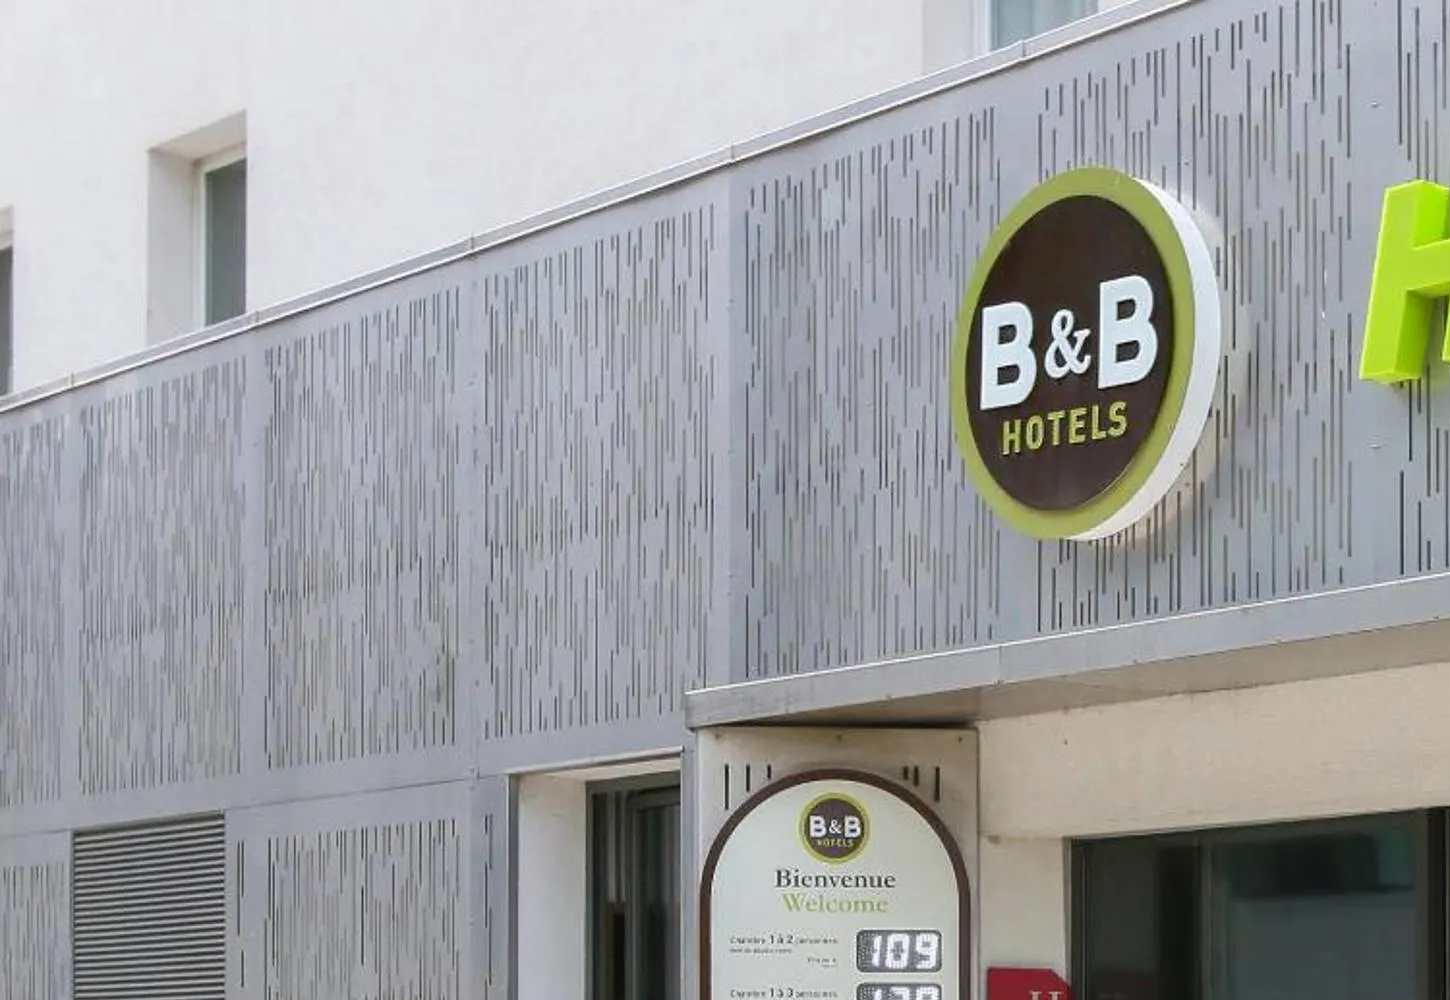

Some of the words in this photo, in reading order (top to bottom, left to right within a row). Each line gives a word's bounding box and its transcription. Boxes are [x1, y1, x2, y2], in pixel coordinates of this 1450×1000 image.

[979, 274, 1159, 411] B&B
[1001, 401, 1129, 455] HOTELS
[808, 814, 862, 838] B&B
[775, 869, 896, 888] Bienvenue
[782, 893, 889, 914] Welcome
[871, 933, 938, 969] 109
